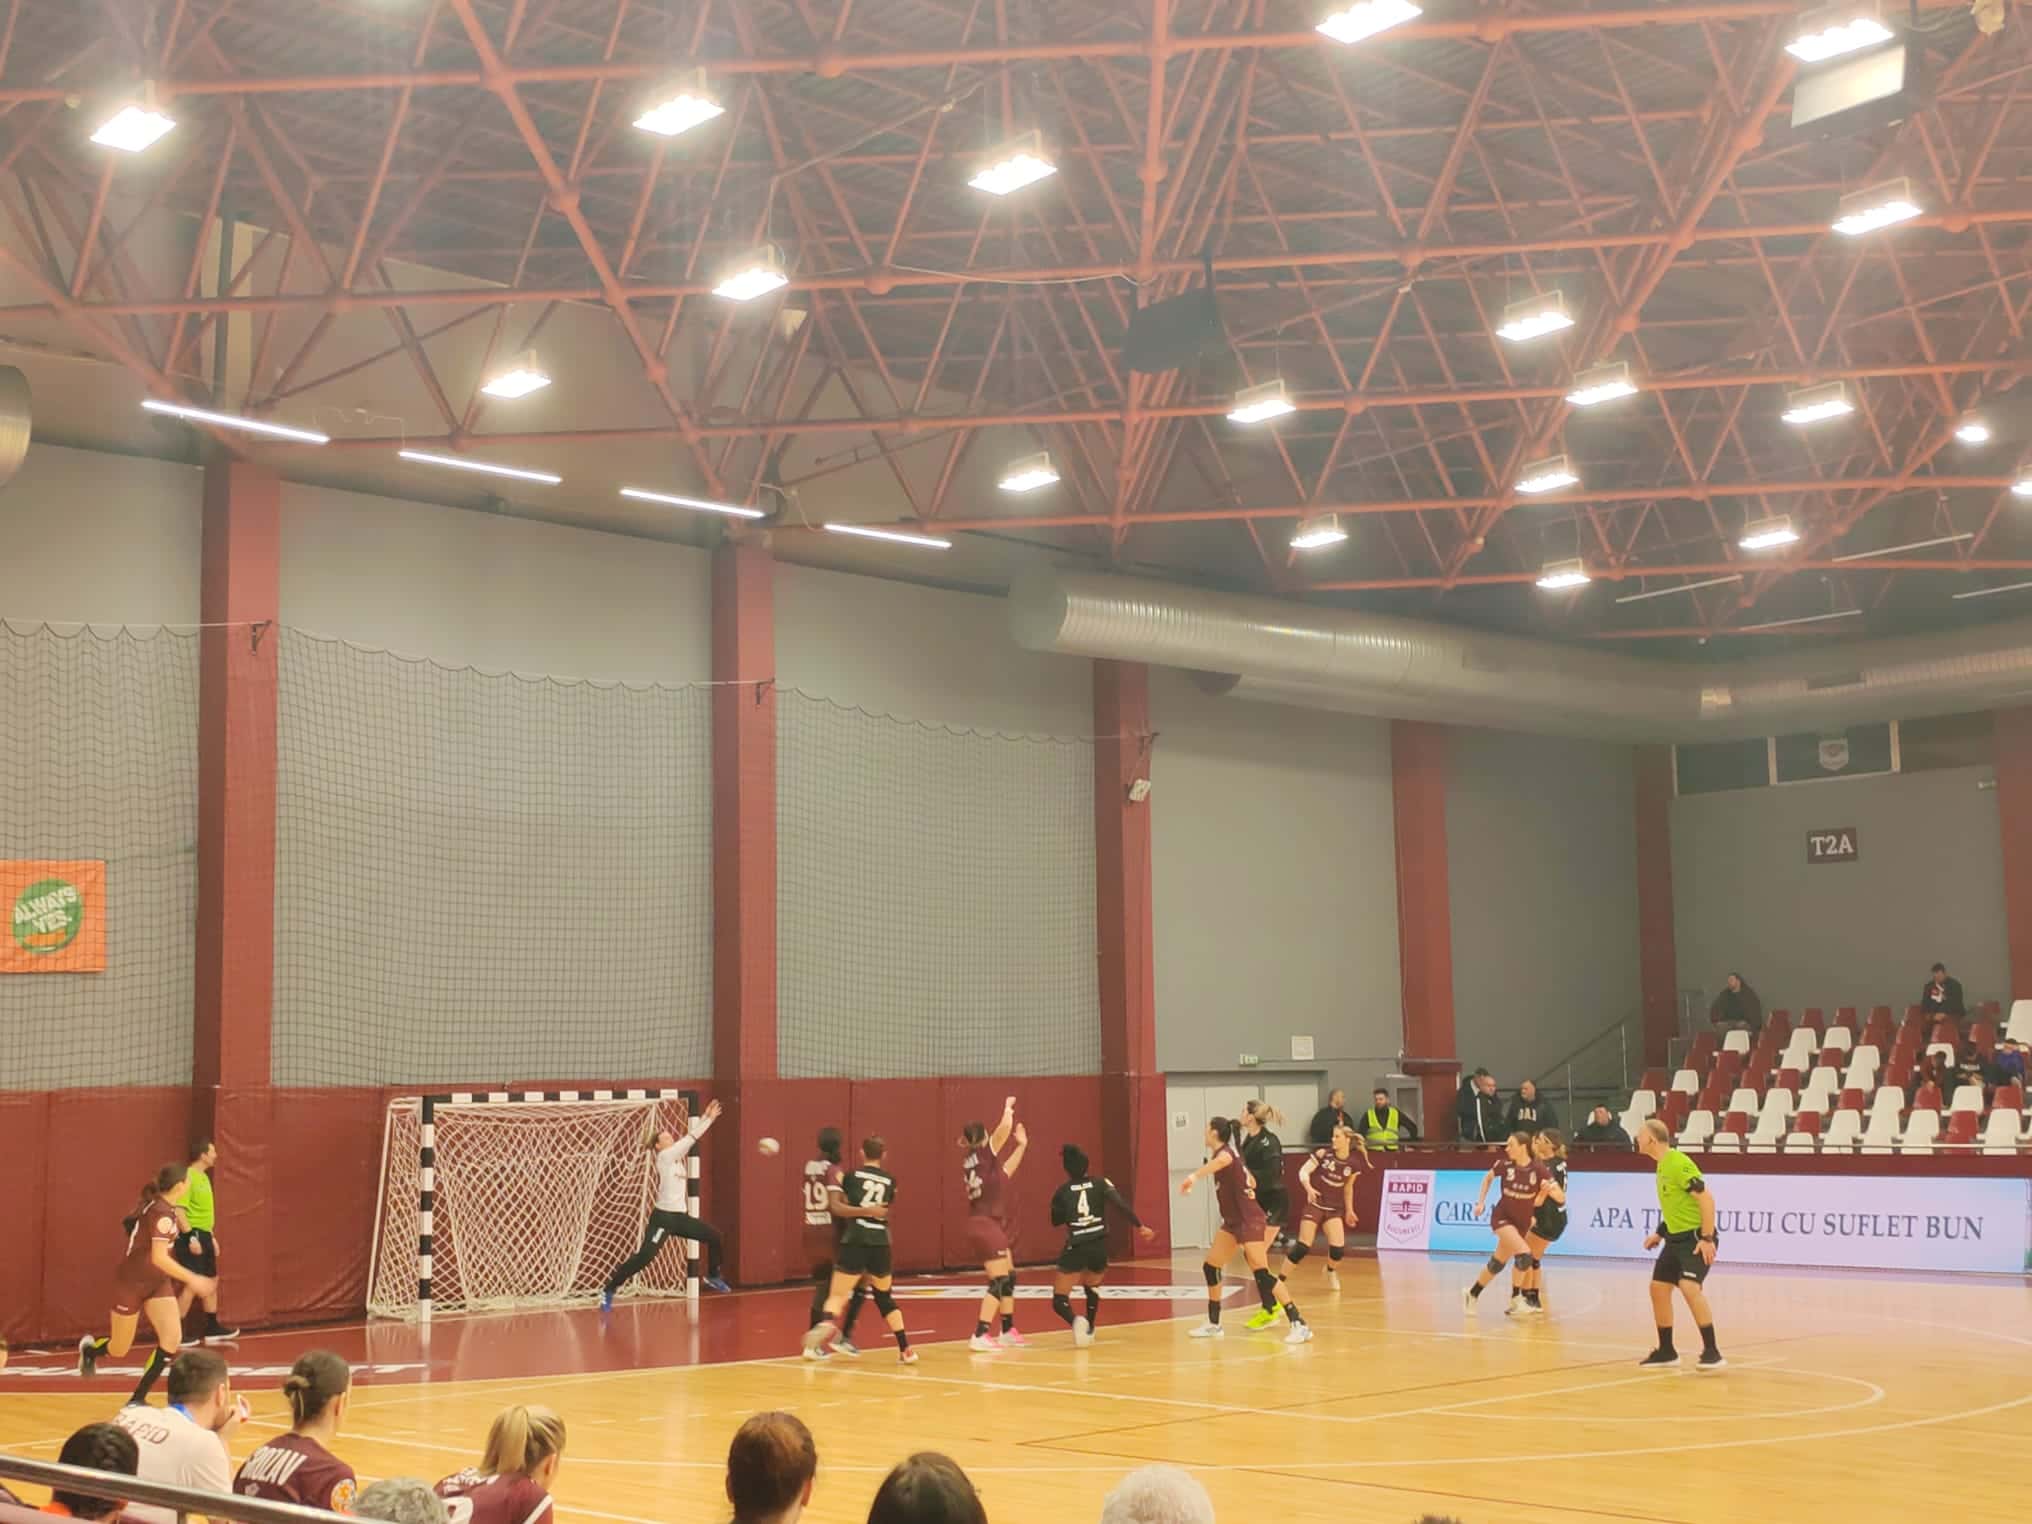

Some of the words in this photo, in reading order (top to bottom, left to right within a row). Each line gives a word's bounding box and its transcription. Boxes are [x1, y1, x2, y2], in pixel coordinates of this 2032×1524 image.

[1810, 834, 1854, 856] T2A
[15, 886, 77, 924] ALWAYS
[804, 1181, 829, 1211] 19
[1392, 1183, 1424, 1193] RAPID
[1076, 1190, 1090, 1217] 4
[1590, 1207, 1634, 1229] APA
[1781, 1211, 1816, 1235] CU
[1822, 1212, 1919, 1238] SUFLET
[1925, 1215, 1984, 1240] BUN
